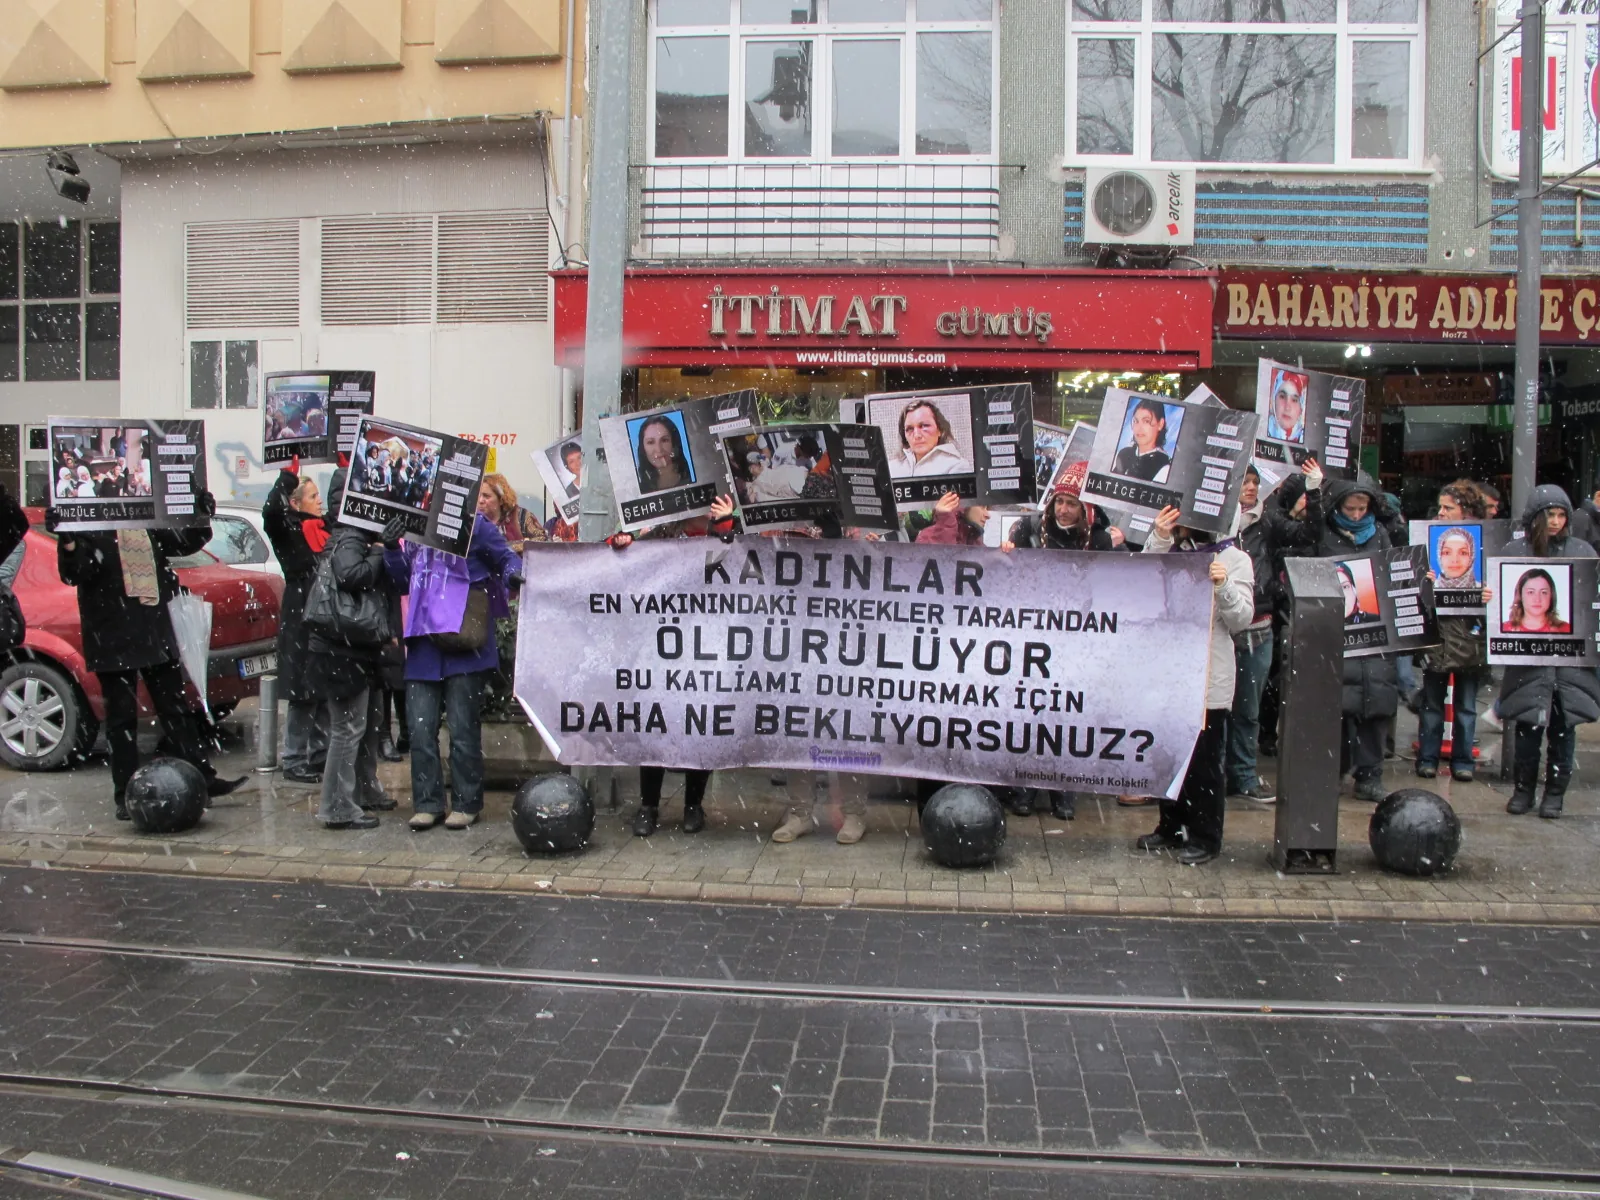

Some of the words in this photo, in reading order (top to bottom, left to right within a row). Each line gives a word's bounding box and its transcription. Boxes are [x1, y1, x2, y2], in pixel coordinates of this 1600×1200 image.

[1167, 171, 1184, 221] arçelik
[708, 284, 907, 335] İTİMAT
[936, 306, 1051, 342] GÜMÜŞ
[1227, 277, 1418, 329] BAHARİYE
[1429, 279, 1563, 332] ADLİE
[1442, 331, 1468, 339] No:72
[458, 433, 518, 447] TR-5707
[895, 487, 913, 502] ŞE
[1087, 478, 1136, 499] HATİCE
[345, 500, 386, 521] KATİL
[623, 498, 665, 521] ŞEHRİ
[745, 508, 797, 522] HATİCE
[704, 550, 984, 597] KADINLAR
[590, 593, 621, 613] EN
[630, 589, 797, 616] YAKININDAKİ
[807, 597, 945, 624] ERKEKLER
[953, 604, 1118, 633] TARAFINDAN
[656, 616, 1053, 679] ÖLDÜRÜLÜYOR
[1491, 640, 1525, 652] SERPİL
[616, 668, 652, 690] BU
[666, 664, 801, 694] KATLİAMI
[816, 673, 1000, 707] DURDURMAK
[1013, 680, 1084, 715] İÇİN
[560, 701, 667, 734] DAHA
[685, 704, 736, 736] NE
[754, 701, 1155, 763] BEKLİYORSUNUZ?
[1014, 767, 1057, 781] İstanbul
[1060, 772, 1105, 787] Feminist
[1107, 776, 1149, 789] Kolektif
